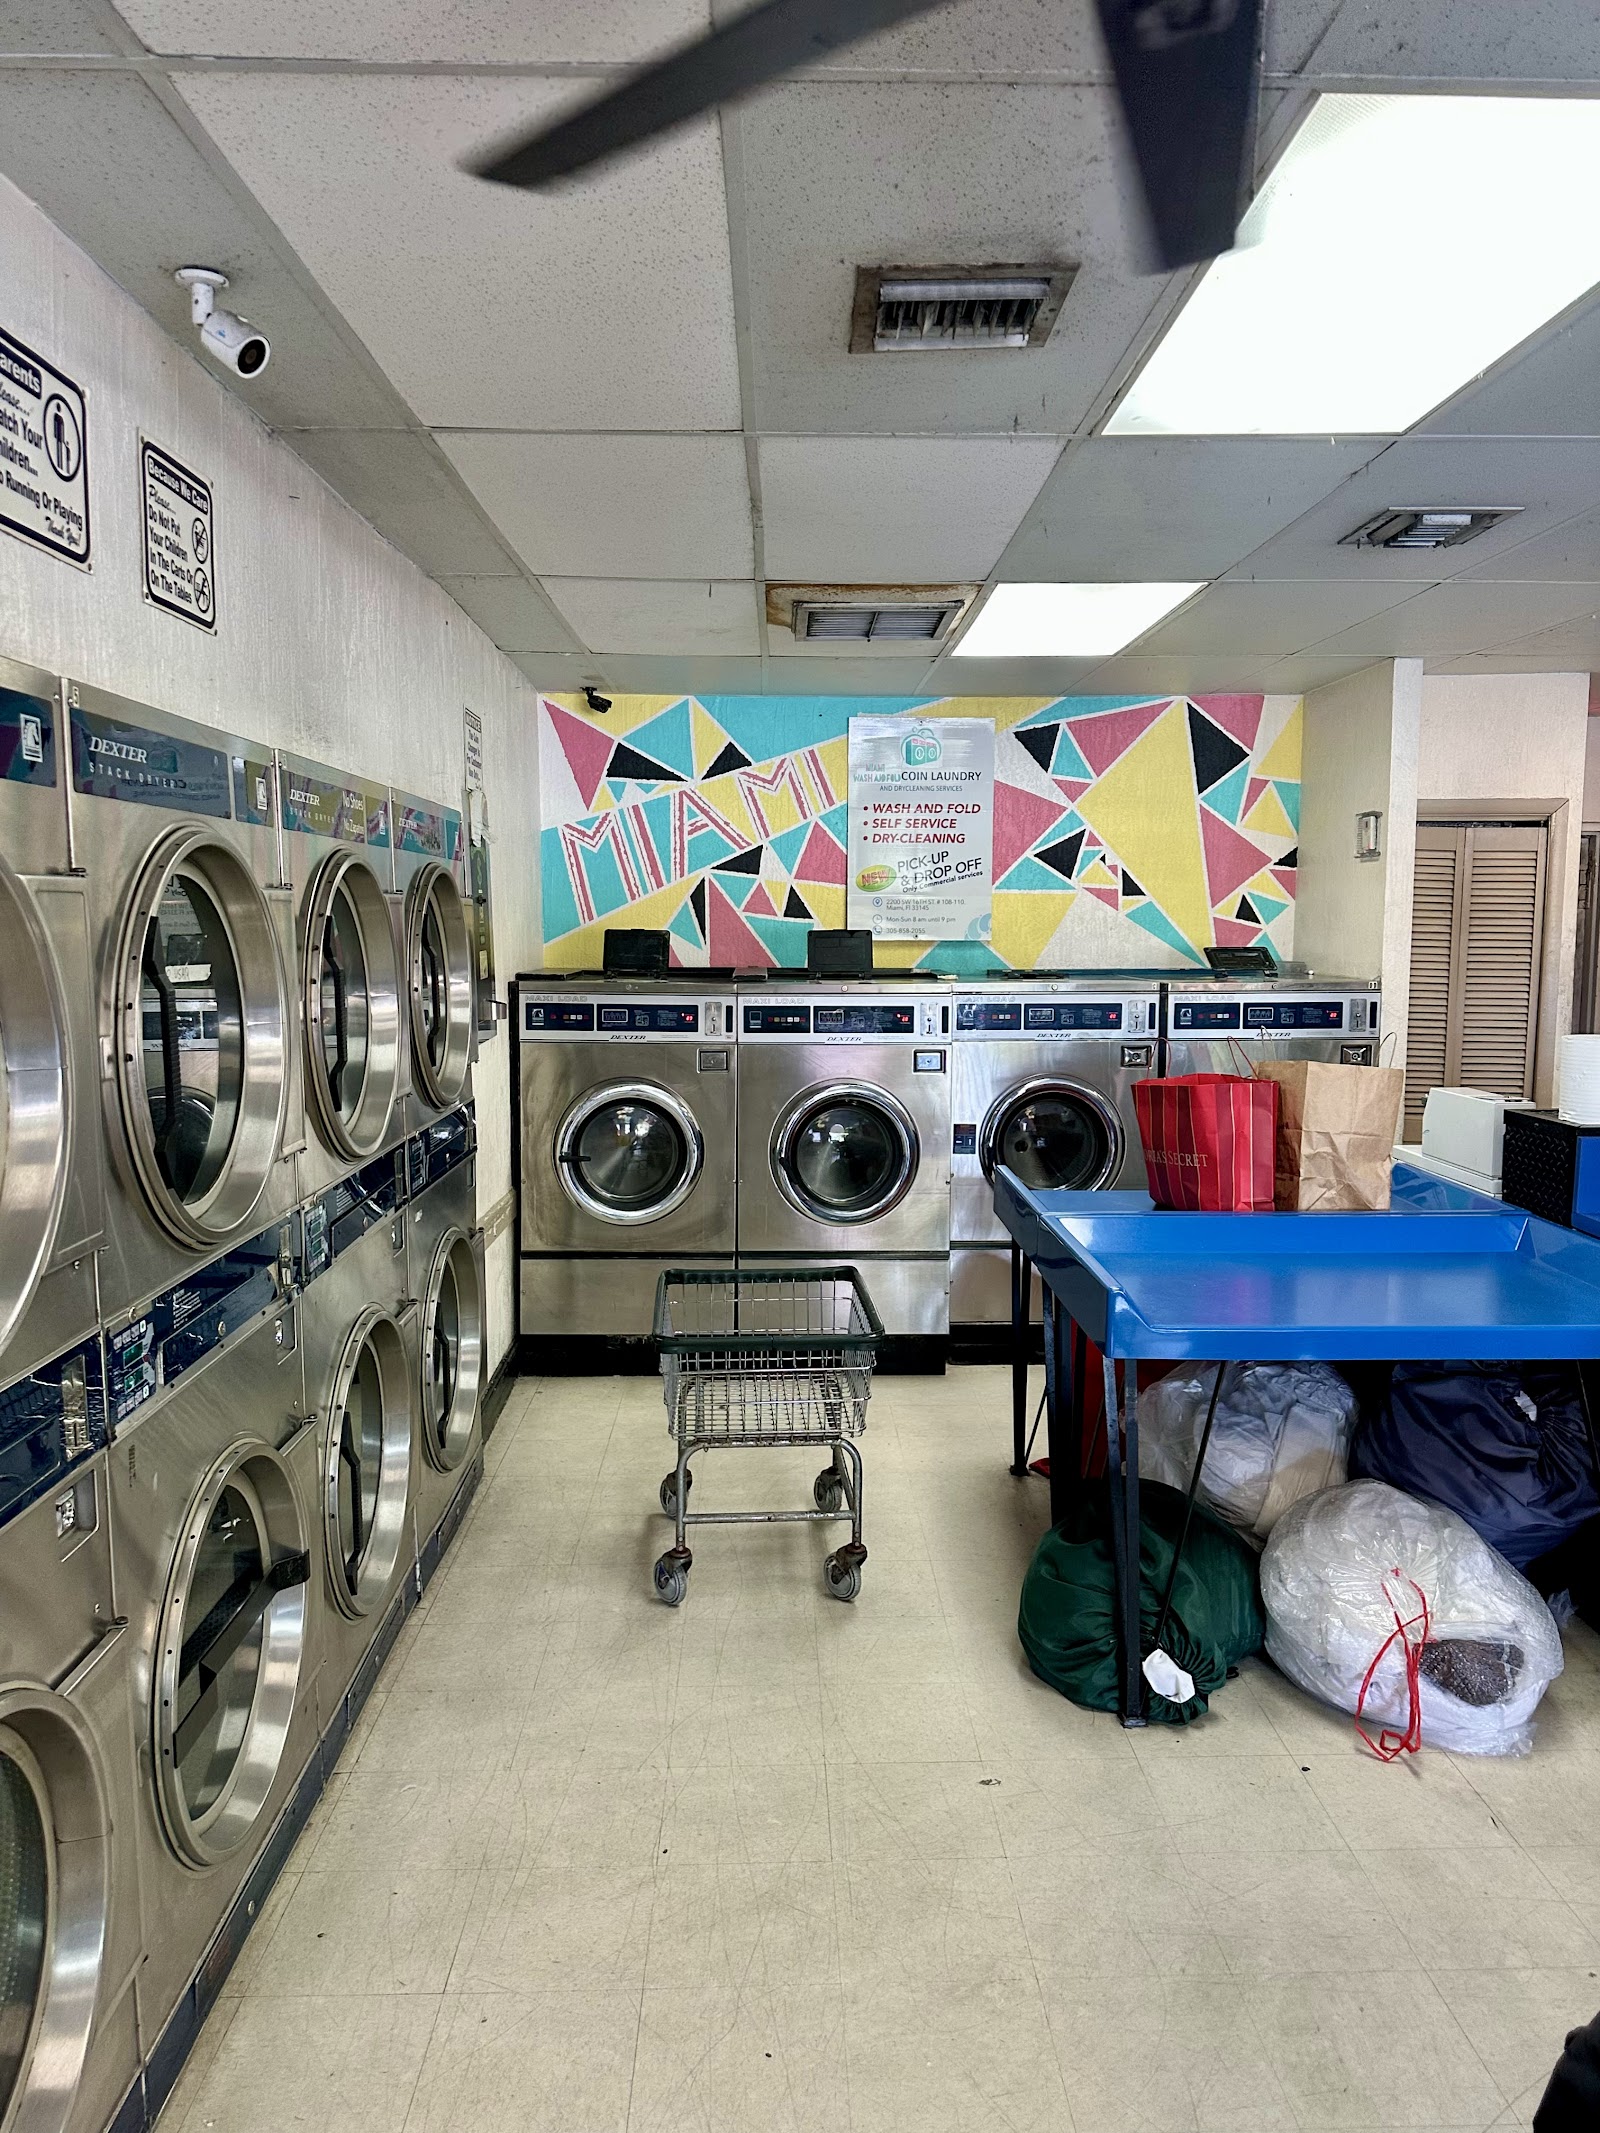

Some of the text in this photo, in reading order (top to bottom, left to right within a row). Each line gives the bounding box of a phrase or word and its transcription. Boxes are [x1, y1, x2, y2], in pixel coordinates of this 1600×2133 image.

[20, 416, 43, 450] Your
[149, 457, 208, 512] Because We Care
[6, 470, 40, 510] Running
[42, 491, 52, 511] Or
[53, 497, 82, 532] Playing
[149, 503, 181, 538] Do Not Put
[149, 524, 188, 563] Your Children
[150, 546, 193, 586] In The Carts Or
[151, 568, 193, 604] On The Tables
[88, 736, 147, 763] DEXTER
[89, 761, 131, 780] STACK
[854, 773, 873, 783] WASH
[901, 771, 928, 781] COIN
[931, 771, 982, 781] LAUNDRY
[289, 788, 320, 807] DEXTER
[350, 792, 364, 811] Shoes
[872, 803, 981, 814] WASH AND FOLD
[872, 818, 957, 829] SELF SERVICE
[560, 749, 837, 925] MIAMI
[872, 833, 966, 844] DRY-CLEANING
[898, 851, 949, 873] PICK-UP
[900, 857, 982, 887] & DROP OFF
[861, 868, 891, 886] NEW
[902, 871, 983, 893] Only Commercial services
[526, 994, 588, 1003] MAXI LOAD
[742, 997, 805, 1005] MAXI LOAD
[1168, 1150, 1209, 1168] SECRET
